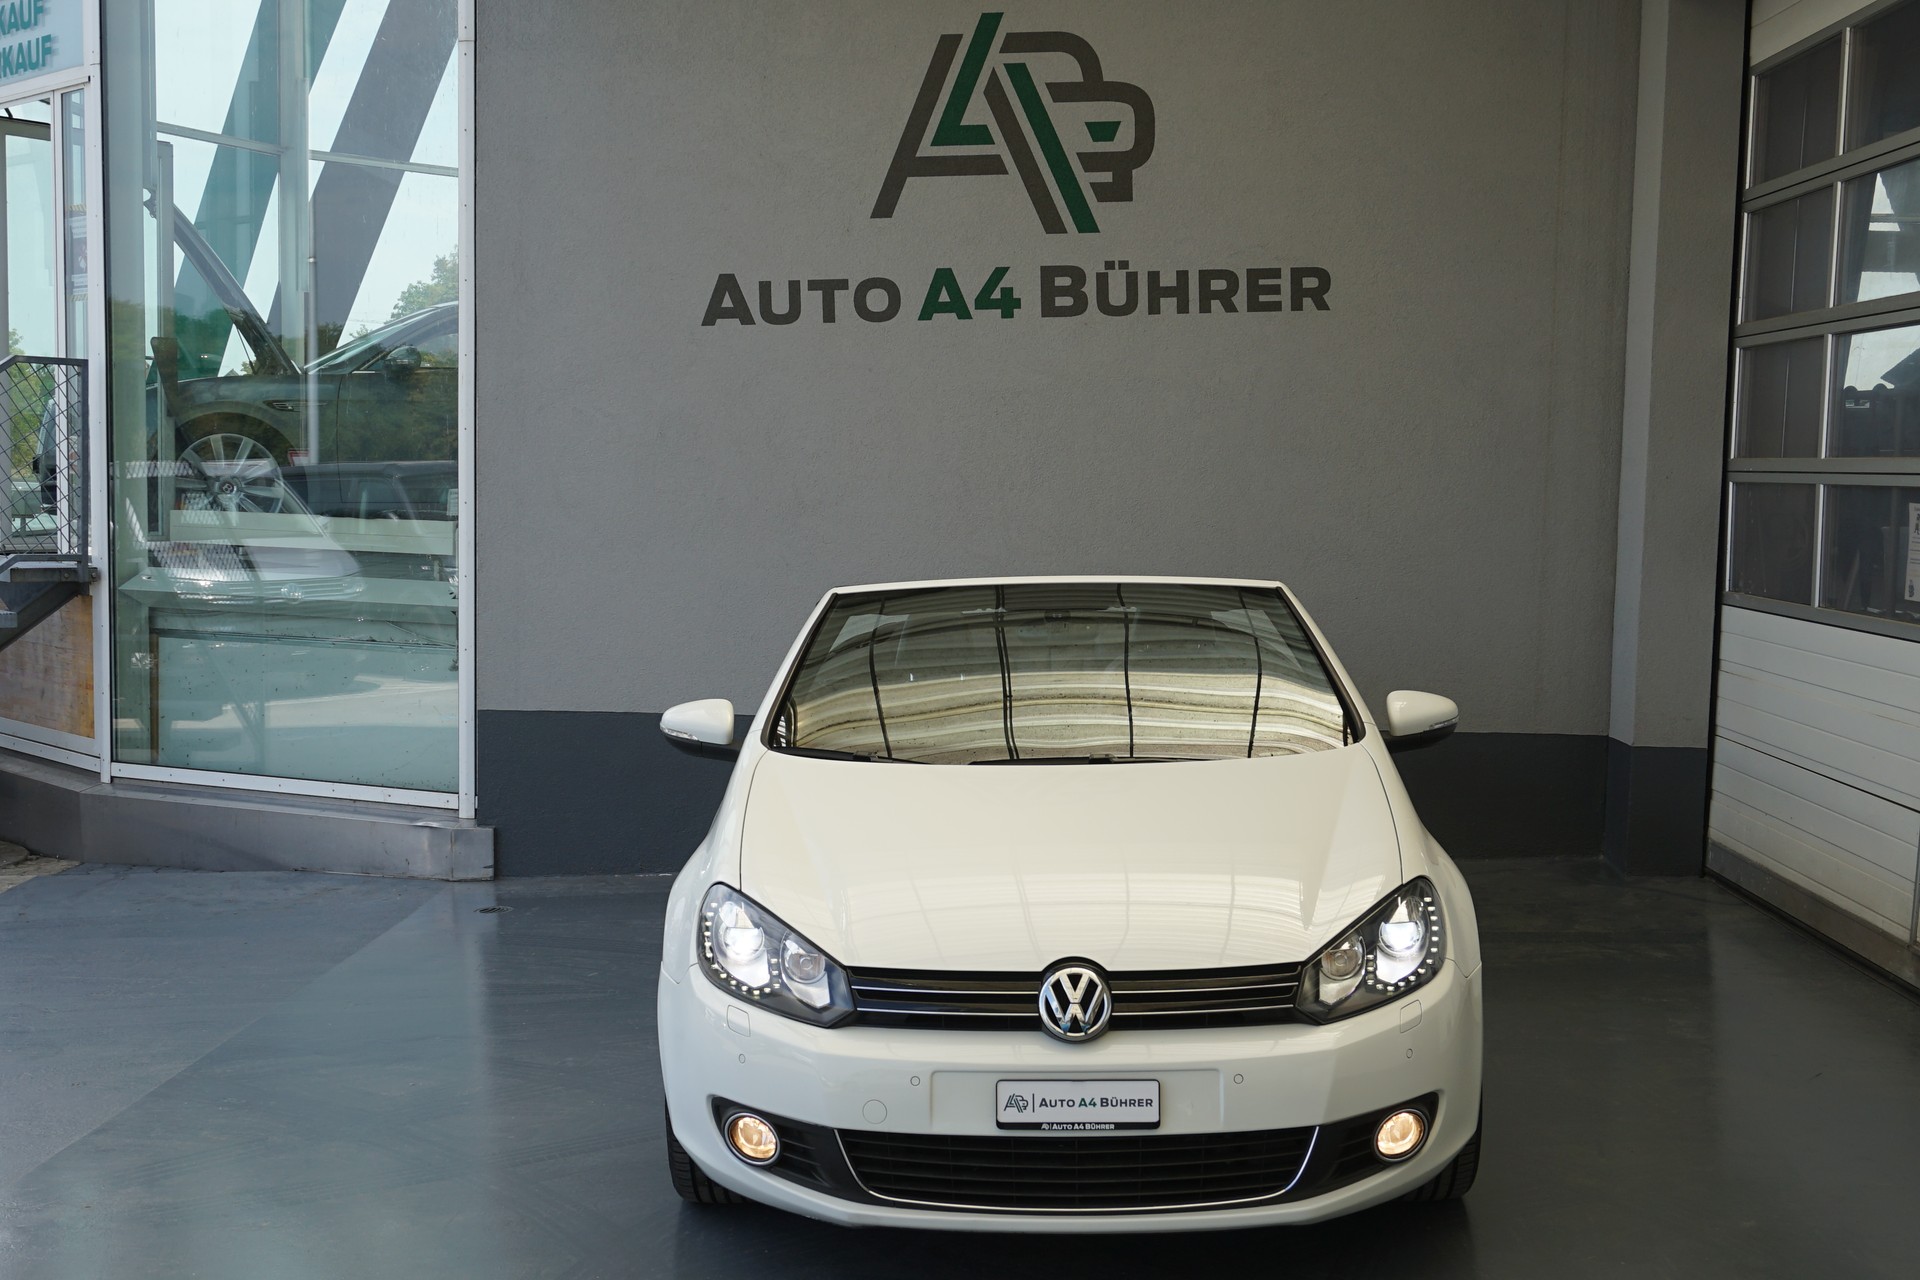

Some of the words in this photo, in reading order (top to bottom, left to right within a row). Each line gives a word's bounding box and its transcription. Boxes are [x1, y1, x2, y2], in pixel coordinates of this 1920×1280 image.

[0, 34, 51, 78] KAUF
[700, 273, 901, 326] AUTO
[917, 266, 1022, 321] A4
[1039, 260, 1332, 319] BÜHRER
[1039, 1097, 1076, 1108] AUTO
[1078, 1097, 1097, 1108] A4
[1100, 1096, 1154, 1108] BÜHRER
[1085, 1122, 1115, 1130] BÜHRER
